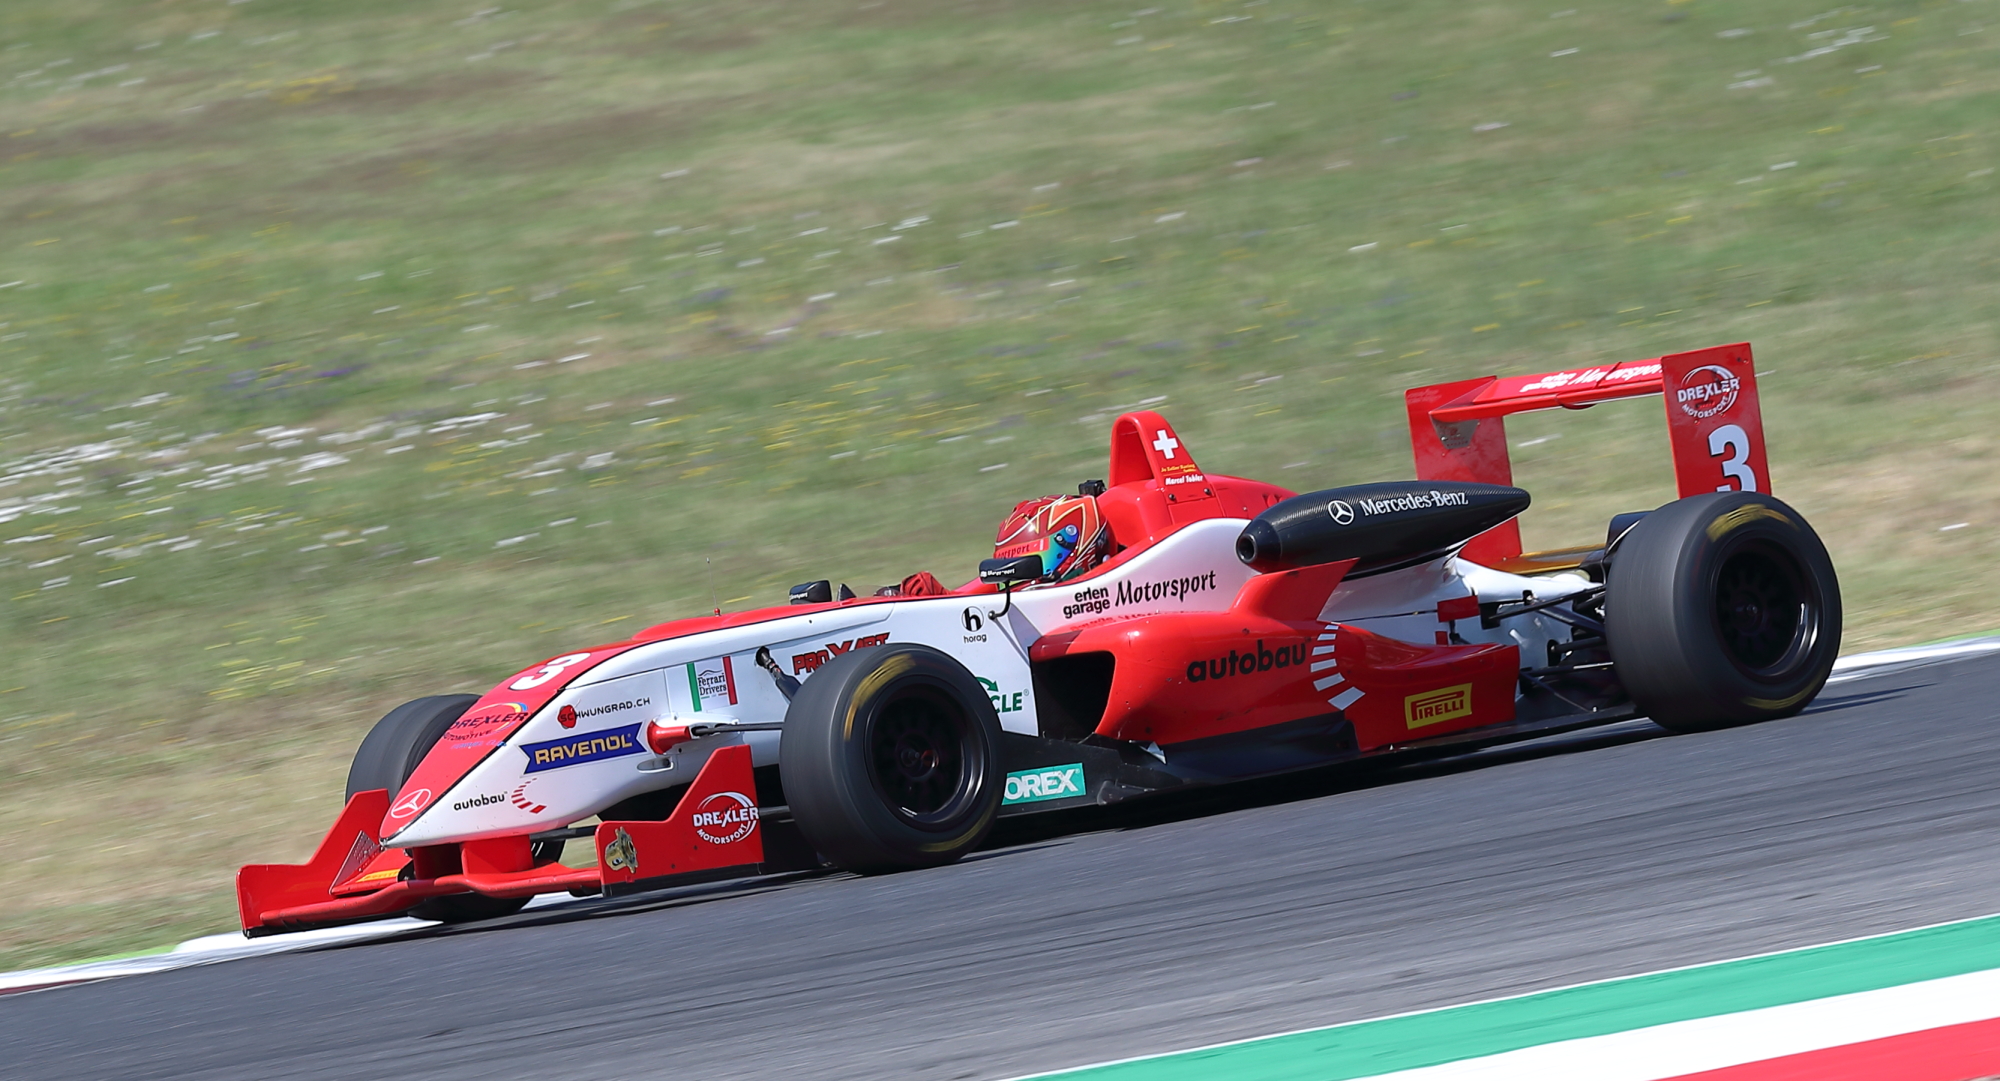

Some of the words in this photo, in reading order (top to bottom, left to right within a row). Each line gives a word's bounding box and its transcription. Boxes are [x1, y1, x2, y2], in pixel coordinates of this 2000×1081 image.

[1568, 363, 1663, 386] Moorspor
[1677, 377, 1740, 403] DREXLER
[1682, 395, 1729, 418] MOTORSPORT
[1708, 424, 1757, 493] 3
[1165, 475, 1185, 485] Marcel
[1359, 490, 1469, 516] Mercedes-Benz
[1063, 599, 1110, 619] garage
[1115, 570, 1216, 607] Motorsport
[1074, 586, 1109, 602] erlen
[963, 633, 987, 644] horag
[508, 652, 591, 690] 3
[1186, 639, 1306, 682] autobau
[698, 673, 725, 686] Ferrari
[699, 684, 727, 695] Drivers
[560, 697, 651, 722] SCHWUNGRAD.CH
[1410, 690, 1464, 721] PIRELLI
[534, 734, 633, 764] RAVENOL
[453, 794, 505, 811] autobau
[693, 807, 759, 827] DREXLER
[697, 823, 747, 844] MOTORSPORT
